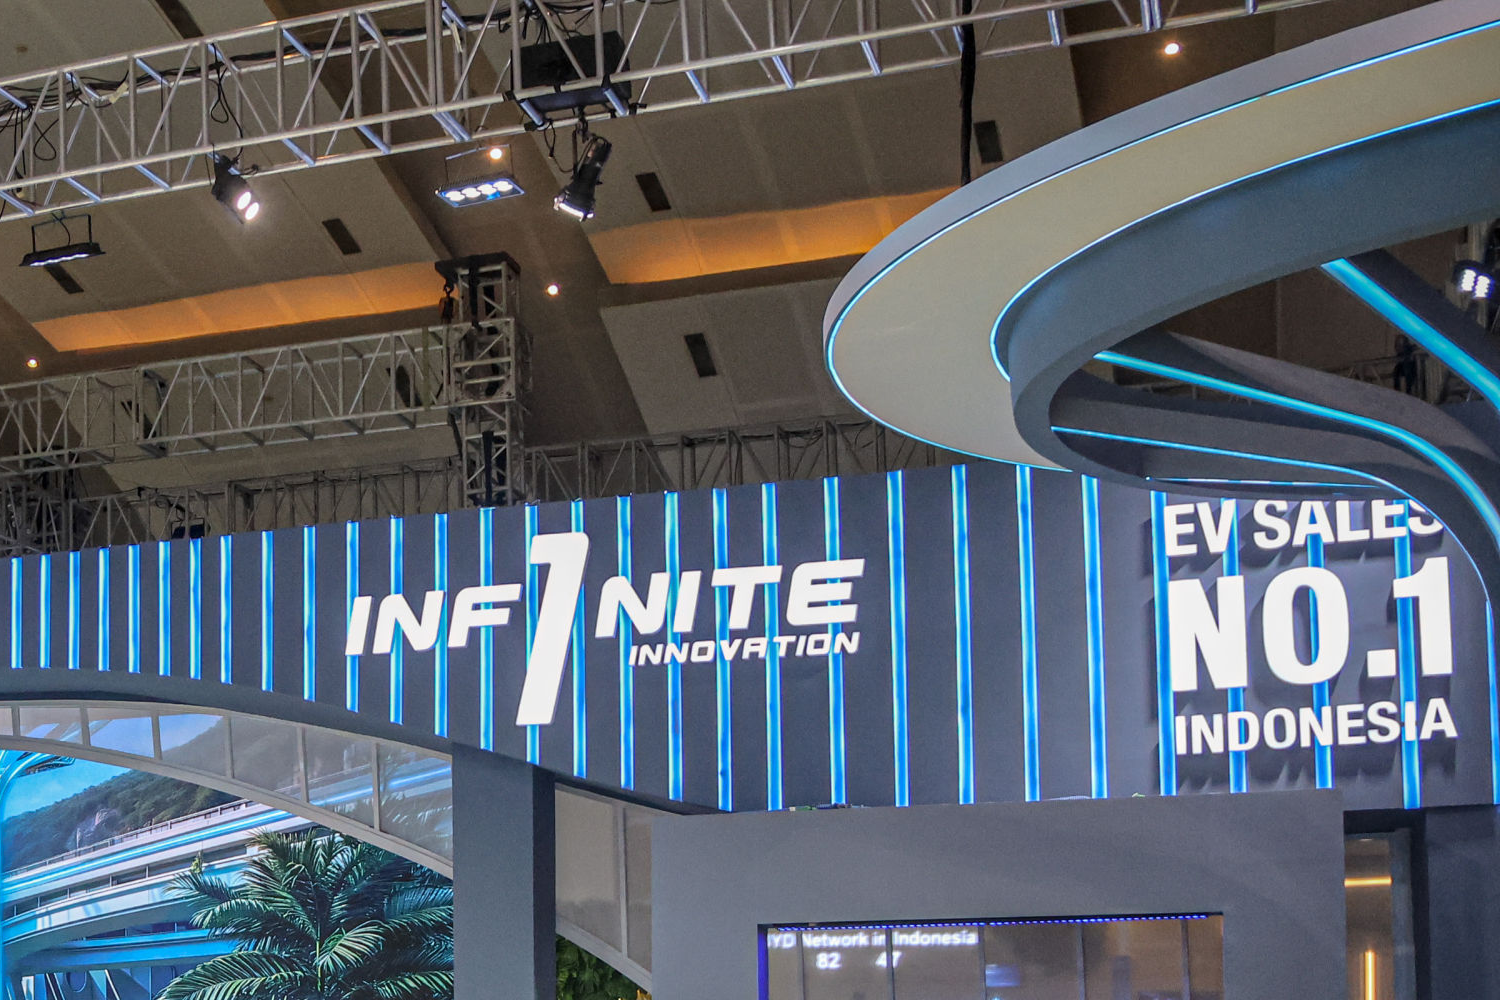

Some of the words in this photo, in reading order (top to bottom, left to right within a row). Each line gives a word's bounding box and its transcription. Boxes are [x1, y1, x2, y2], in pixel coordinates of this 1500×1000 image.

[1164, 500, 1238, 557] EV
[1253, 499, 1444, 549] SALES
[1168, 556, 1454, 692] NO.1
[629, 631, 860, 667] INNOVATION
[1175, 697, 1459, 756] INDONESIA
[768, 932, 797, 949] YD
[803, 932, 869, 948] Network
[871, 931, 886, 946] in
[893, 929, 979, 946] Indonesia
[815, 951, 842, 970] 82
